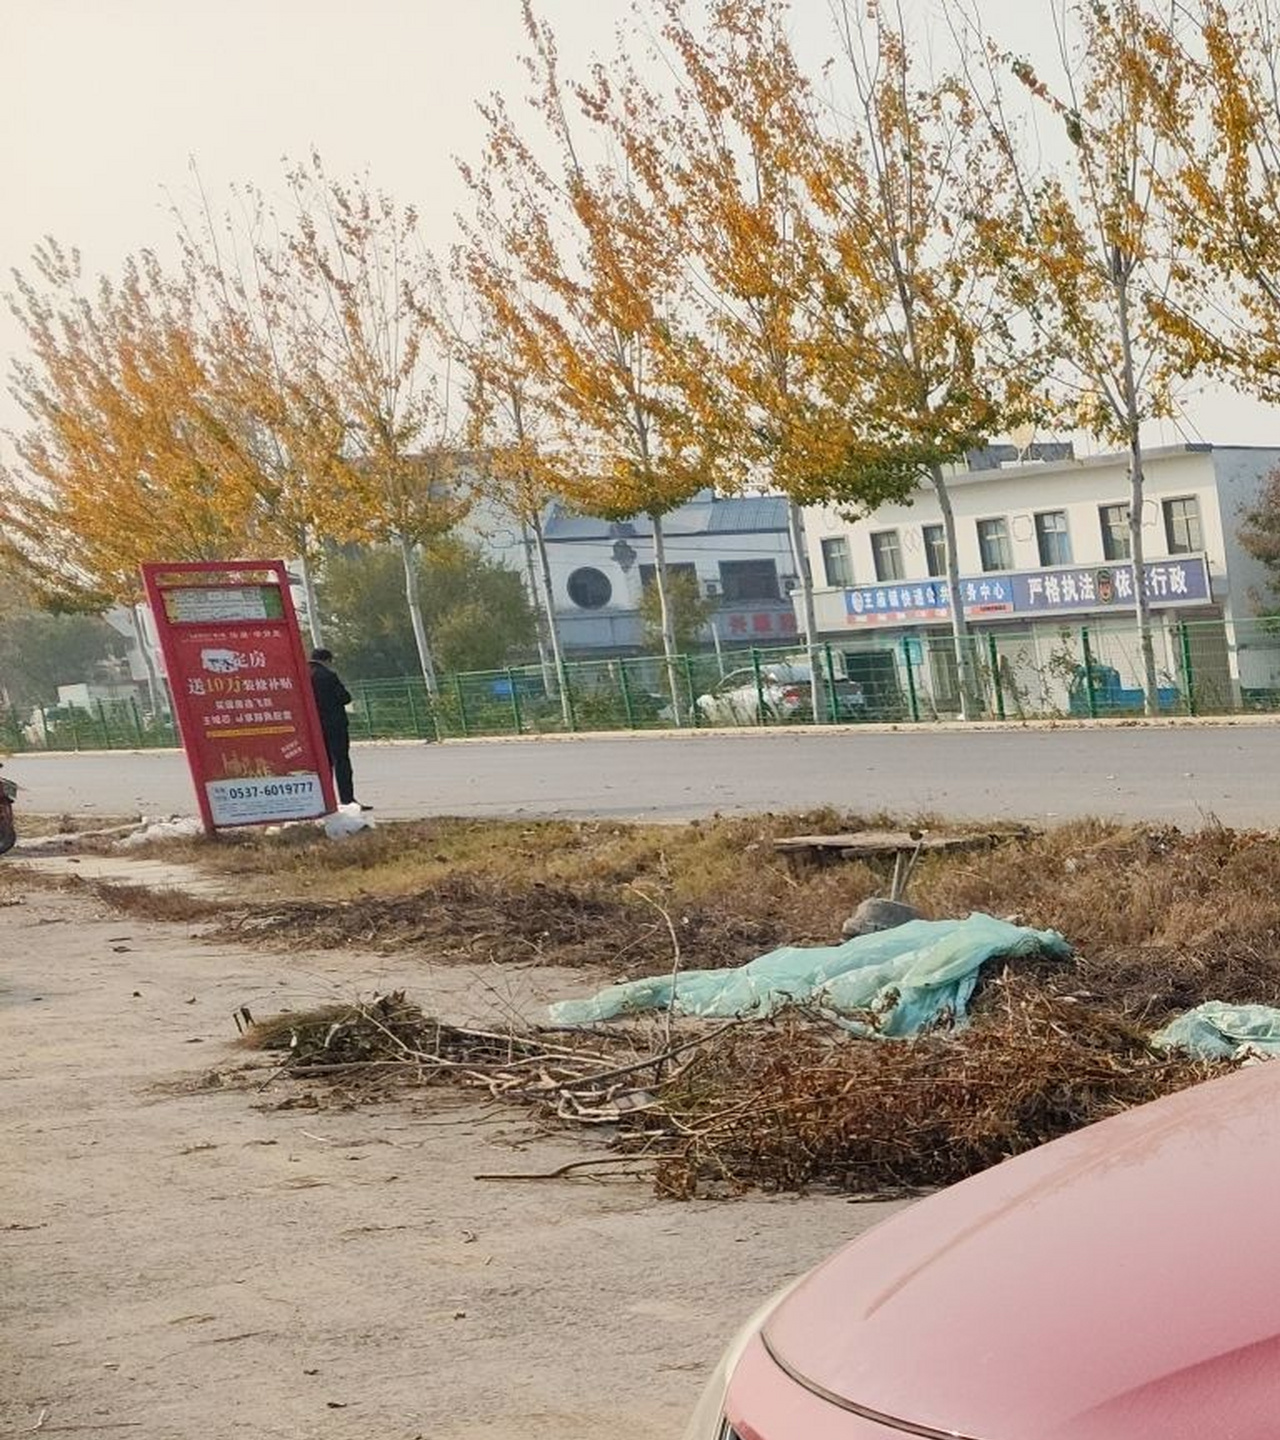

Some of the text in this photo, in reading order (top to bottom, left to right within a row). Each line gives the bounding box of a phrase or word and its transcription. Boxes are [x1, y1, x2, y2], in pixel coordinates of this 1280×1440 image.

[863, 581, 1005, 609] 王庙镇快递公共务中心
[1027, 565, 1188, 604] 严格执法 依行政
[229, 781, 313, 800] 0537-6019777
